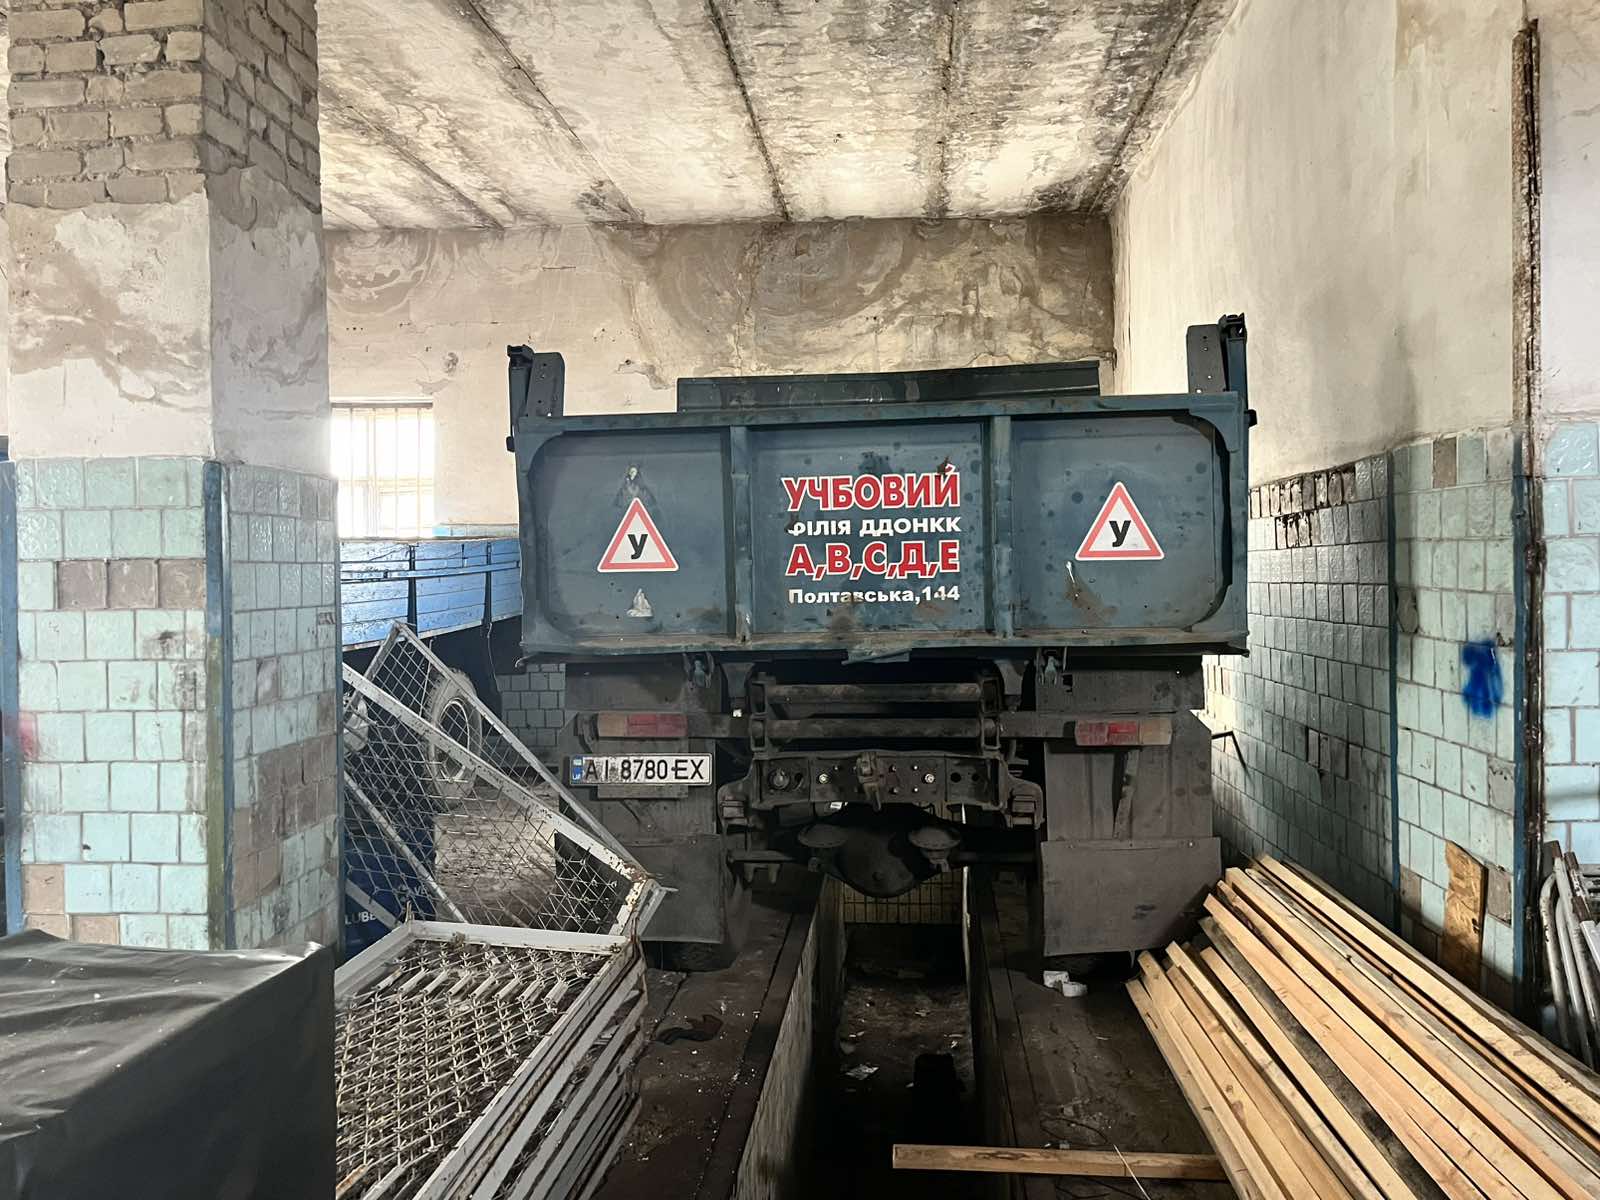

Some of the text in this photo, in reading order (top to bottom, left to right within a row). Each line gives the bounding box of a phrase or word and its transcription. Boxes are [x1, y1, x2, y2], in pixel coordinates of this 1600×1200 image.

[781, 464, 960, 512] УЧБОВИЙ
[859, 517, 961, 537] ДДОНКК
[585, 759, 704, 780] AI 8780 EX
